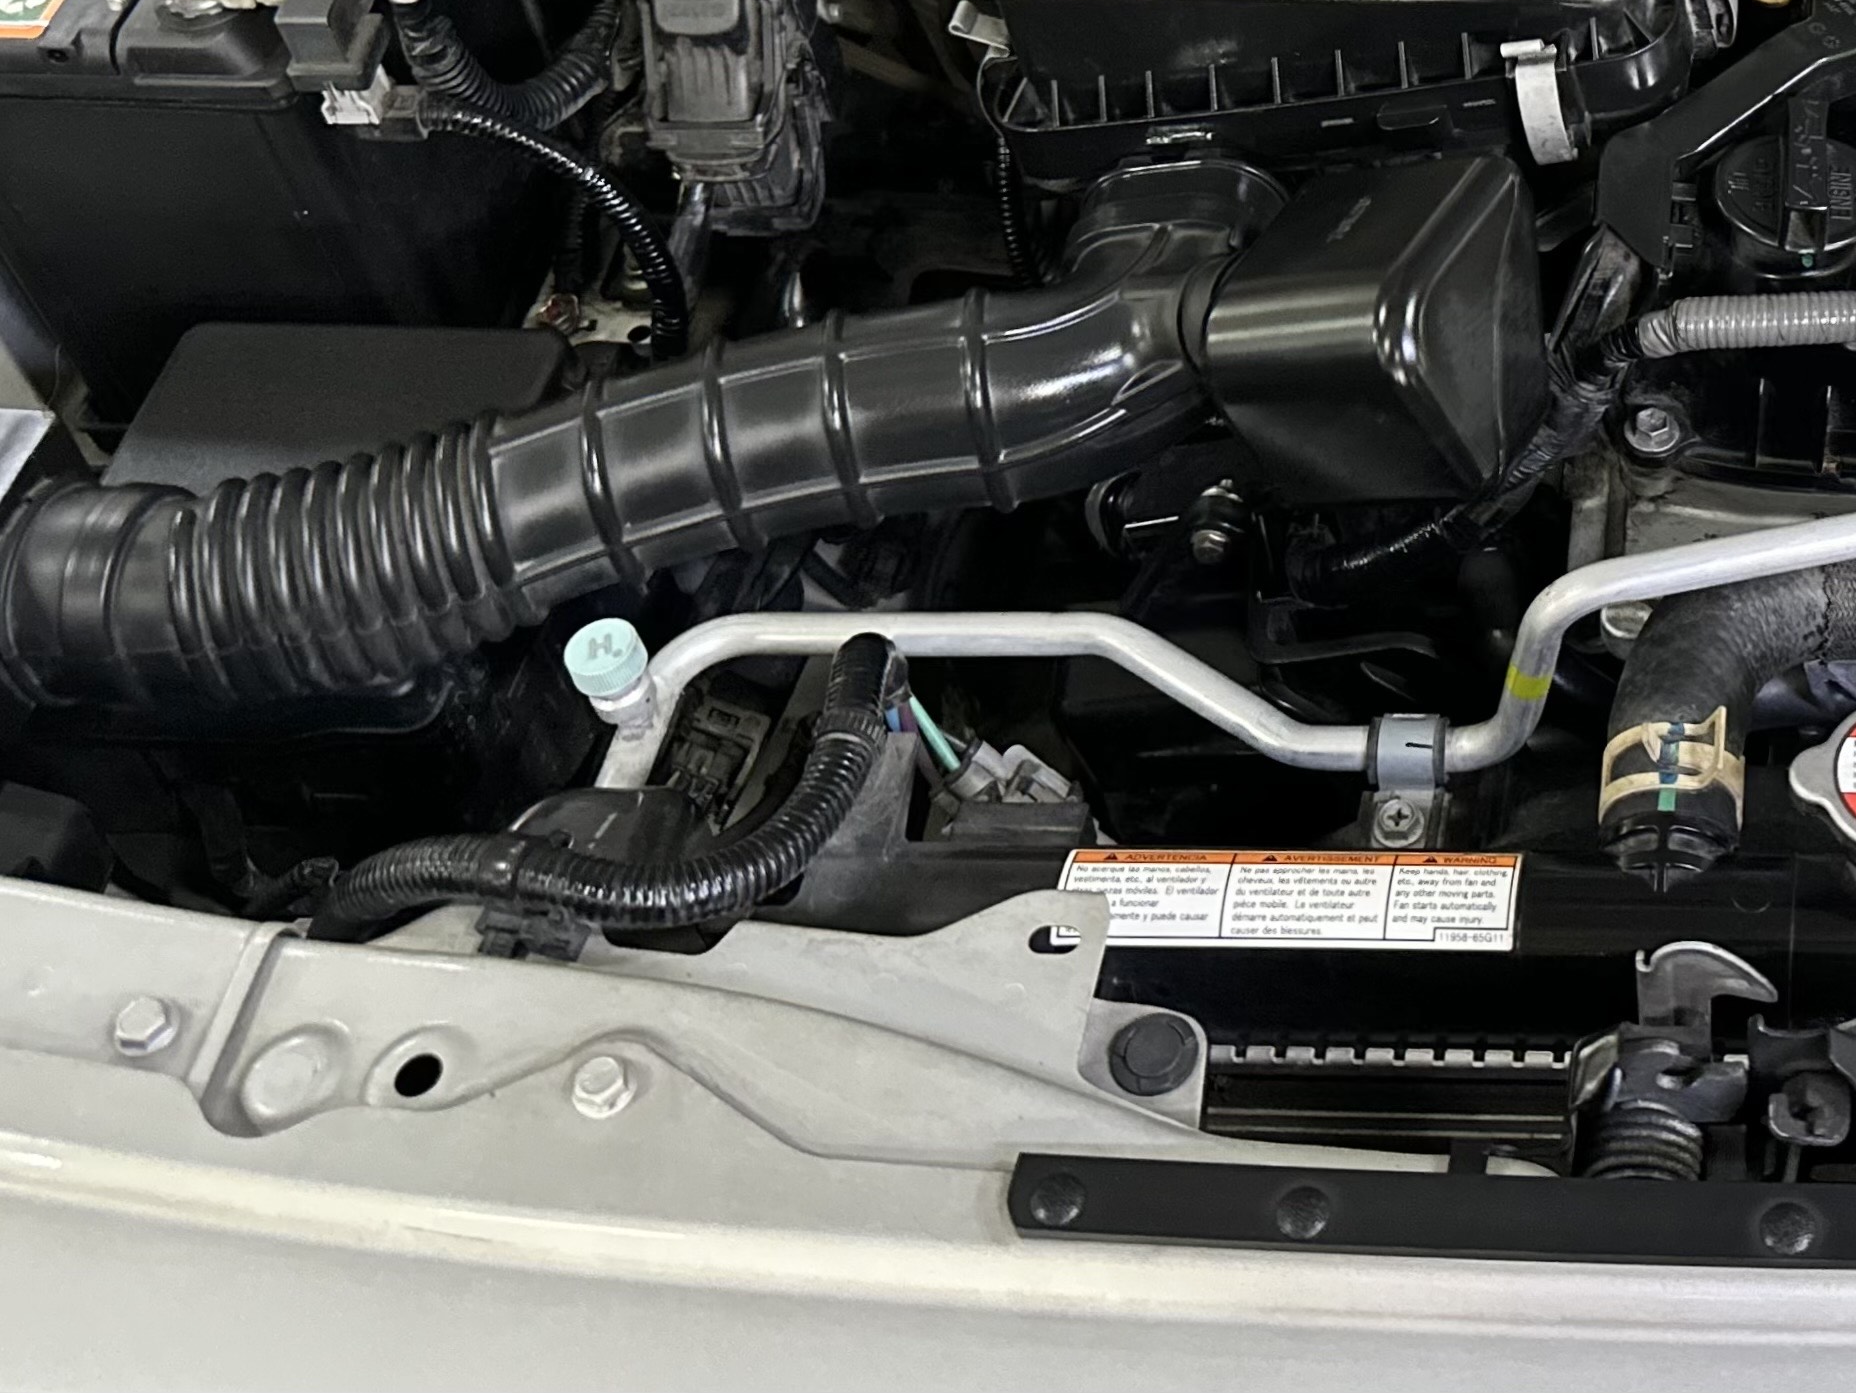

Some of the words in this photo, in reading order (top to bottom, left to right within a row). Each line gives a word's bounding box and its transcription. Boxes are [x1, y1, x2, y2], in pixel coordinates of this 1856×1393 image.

[1829, 165, 1854, 221] ENGINE
[1124, 853, 1208, 861] ADVERTENCIA
[1283, 855, 1381, 863] AVERTISSEMENT
[1443, 856, 1498, 864] WARNING
[1076, 865, 1089, 873] No
[1091, 866, 1125, 874] acerque
[1128, 865, 1140, 873] las
[1254, 868, 1270, 876] pas
[1272, 867, 1315, 876] approcher
[1399, 868, 1421, 876] Keep
[1156, 876, 1198, 884] ventilador
[1200, 877, 1207, 885] y
[1278, 877, 1290, 885] les
[1293, 877, 1338, 885] vêtements
[1354, 878, 1377, 886] autre
[1417, 878, 1440, 887] away
[1442, 878, 1463, 886] from
[1465, 878, 1479, 886] fan
[1480, 878, 1497, 886] and
[1176, 887, 1219, 896] ventilador
[1235, 887, 1246, 896] du
[1248, 887, 1294, 896] ventilateur
[1297, 887, 1306, 897] et
[1309, 887, 1320, 897] de
[1322, 889, 1346, 897] toute
[1348, 888, 1371, 897] autre
[1395, 889, 1410, 898] any
[1413, 889, 1437, 897] other
[1438, 889, 1469, 899] moving
[1471, 889, 1496, 899] parts.
[1119, 898, 1160, 908] funcionar
[1232, 900, 1256, 910] pièce
[1308, 900, 1355, 909] ventilateur
[1393, 901, 1410, 910] Fan
[1412, 901, 1438, 910] starts
[1440, 901, 1497, 912] automatically
[1143, 913, 1149, 922] y
[1151, 912, 1177, 922] puede
[1180, 912, 1209, 921] causar
[1232, 912, 1267, 922] démarre
[1269, 912, 1344, 924] automatiquement
[1346, 913, 1356, 922] et
[1358, 913, 1378, 924] peut
[1392, 914, 1408, 923] and
[1410, 915, 1428, 924] may
[1431, 915, 1456, 924] cause
[1230, 926, 1259, 935] causer
[1262, 925, 1277, 935] des
